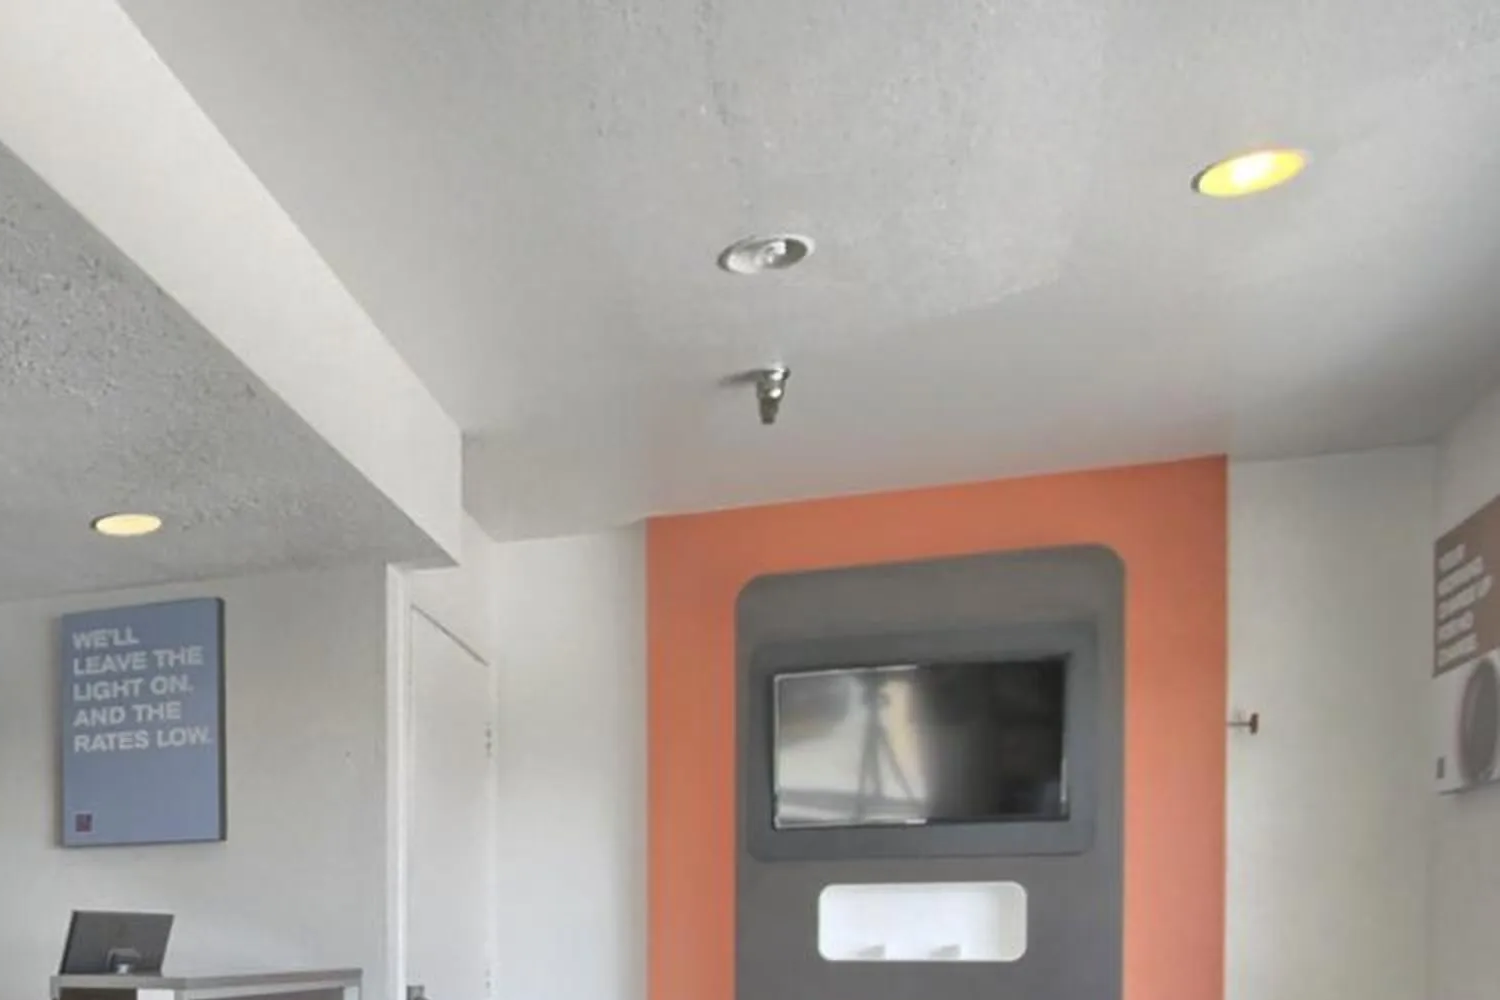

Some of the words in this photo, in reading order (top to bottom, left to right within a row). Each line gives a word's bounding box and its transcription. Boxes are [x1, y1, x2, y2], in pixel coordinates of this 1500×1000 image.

[73, 651, 148, 675] LEAVE
[153, 645, 204, 668] THE
[74, 678, 144, 701] LIGHT
[73, 705, 126, 727] AND
[132, 701, 182, 723] THE
[74, 729, 149, 753] RATES
